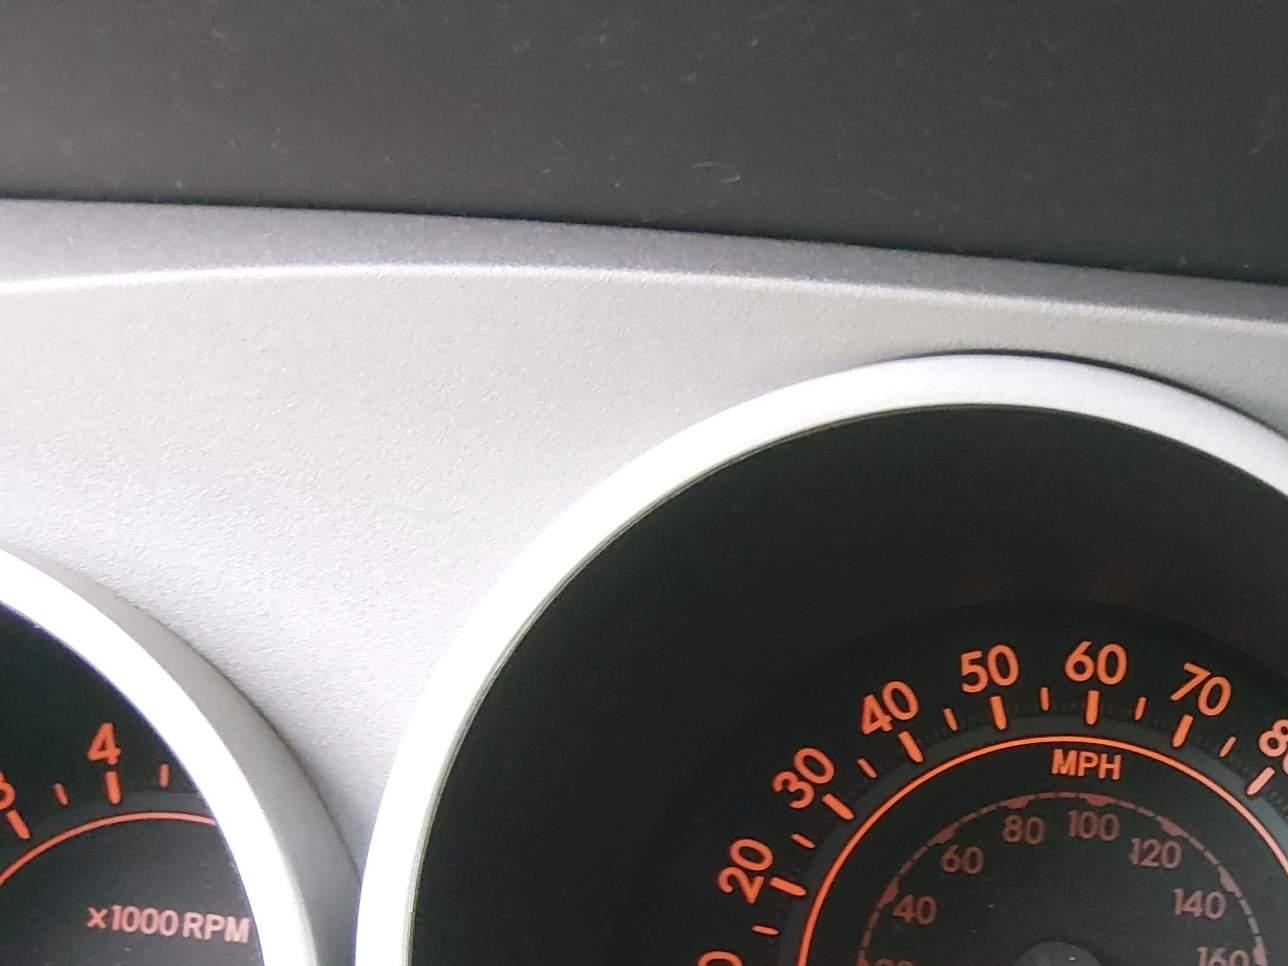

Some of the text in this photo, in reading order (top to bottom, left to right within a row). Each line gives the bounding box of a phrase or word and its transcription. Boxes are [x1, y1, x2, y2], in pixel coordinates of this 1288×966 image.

[961, 645, 1018, 692] 50
[1065, 641, 1126, 684] 60
[1171, 663, 1231, 715] 70
[862, 681, 918, 738] 40
[88, 723, 120, 765] 4
[773, 748, 835, 808] 30
[1052, 745, 1124, 779] MPH
[1003, 815, 1045, 844] 80
[1069, 810, 1119, 841] 100
[942, 845, 982, 874] 60
[1130, 833, 1185, 868] 120
[718, 839, 775, 903] 20
[890, 893, 936, 924] 40
[1174, 884, 1230, 919] 140
[183, 912, 252, 943] RPM
